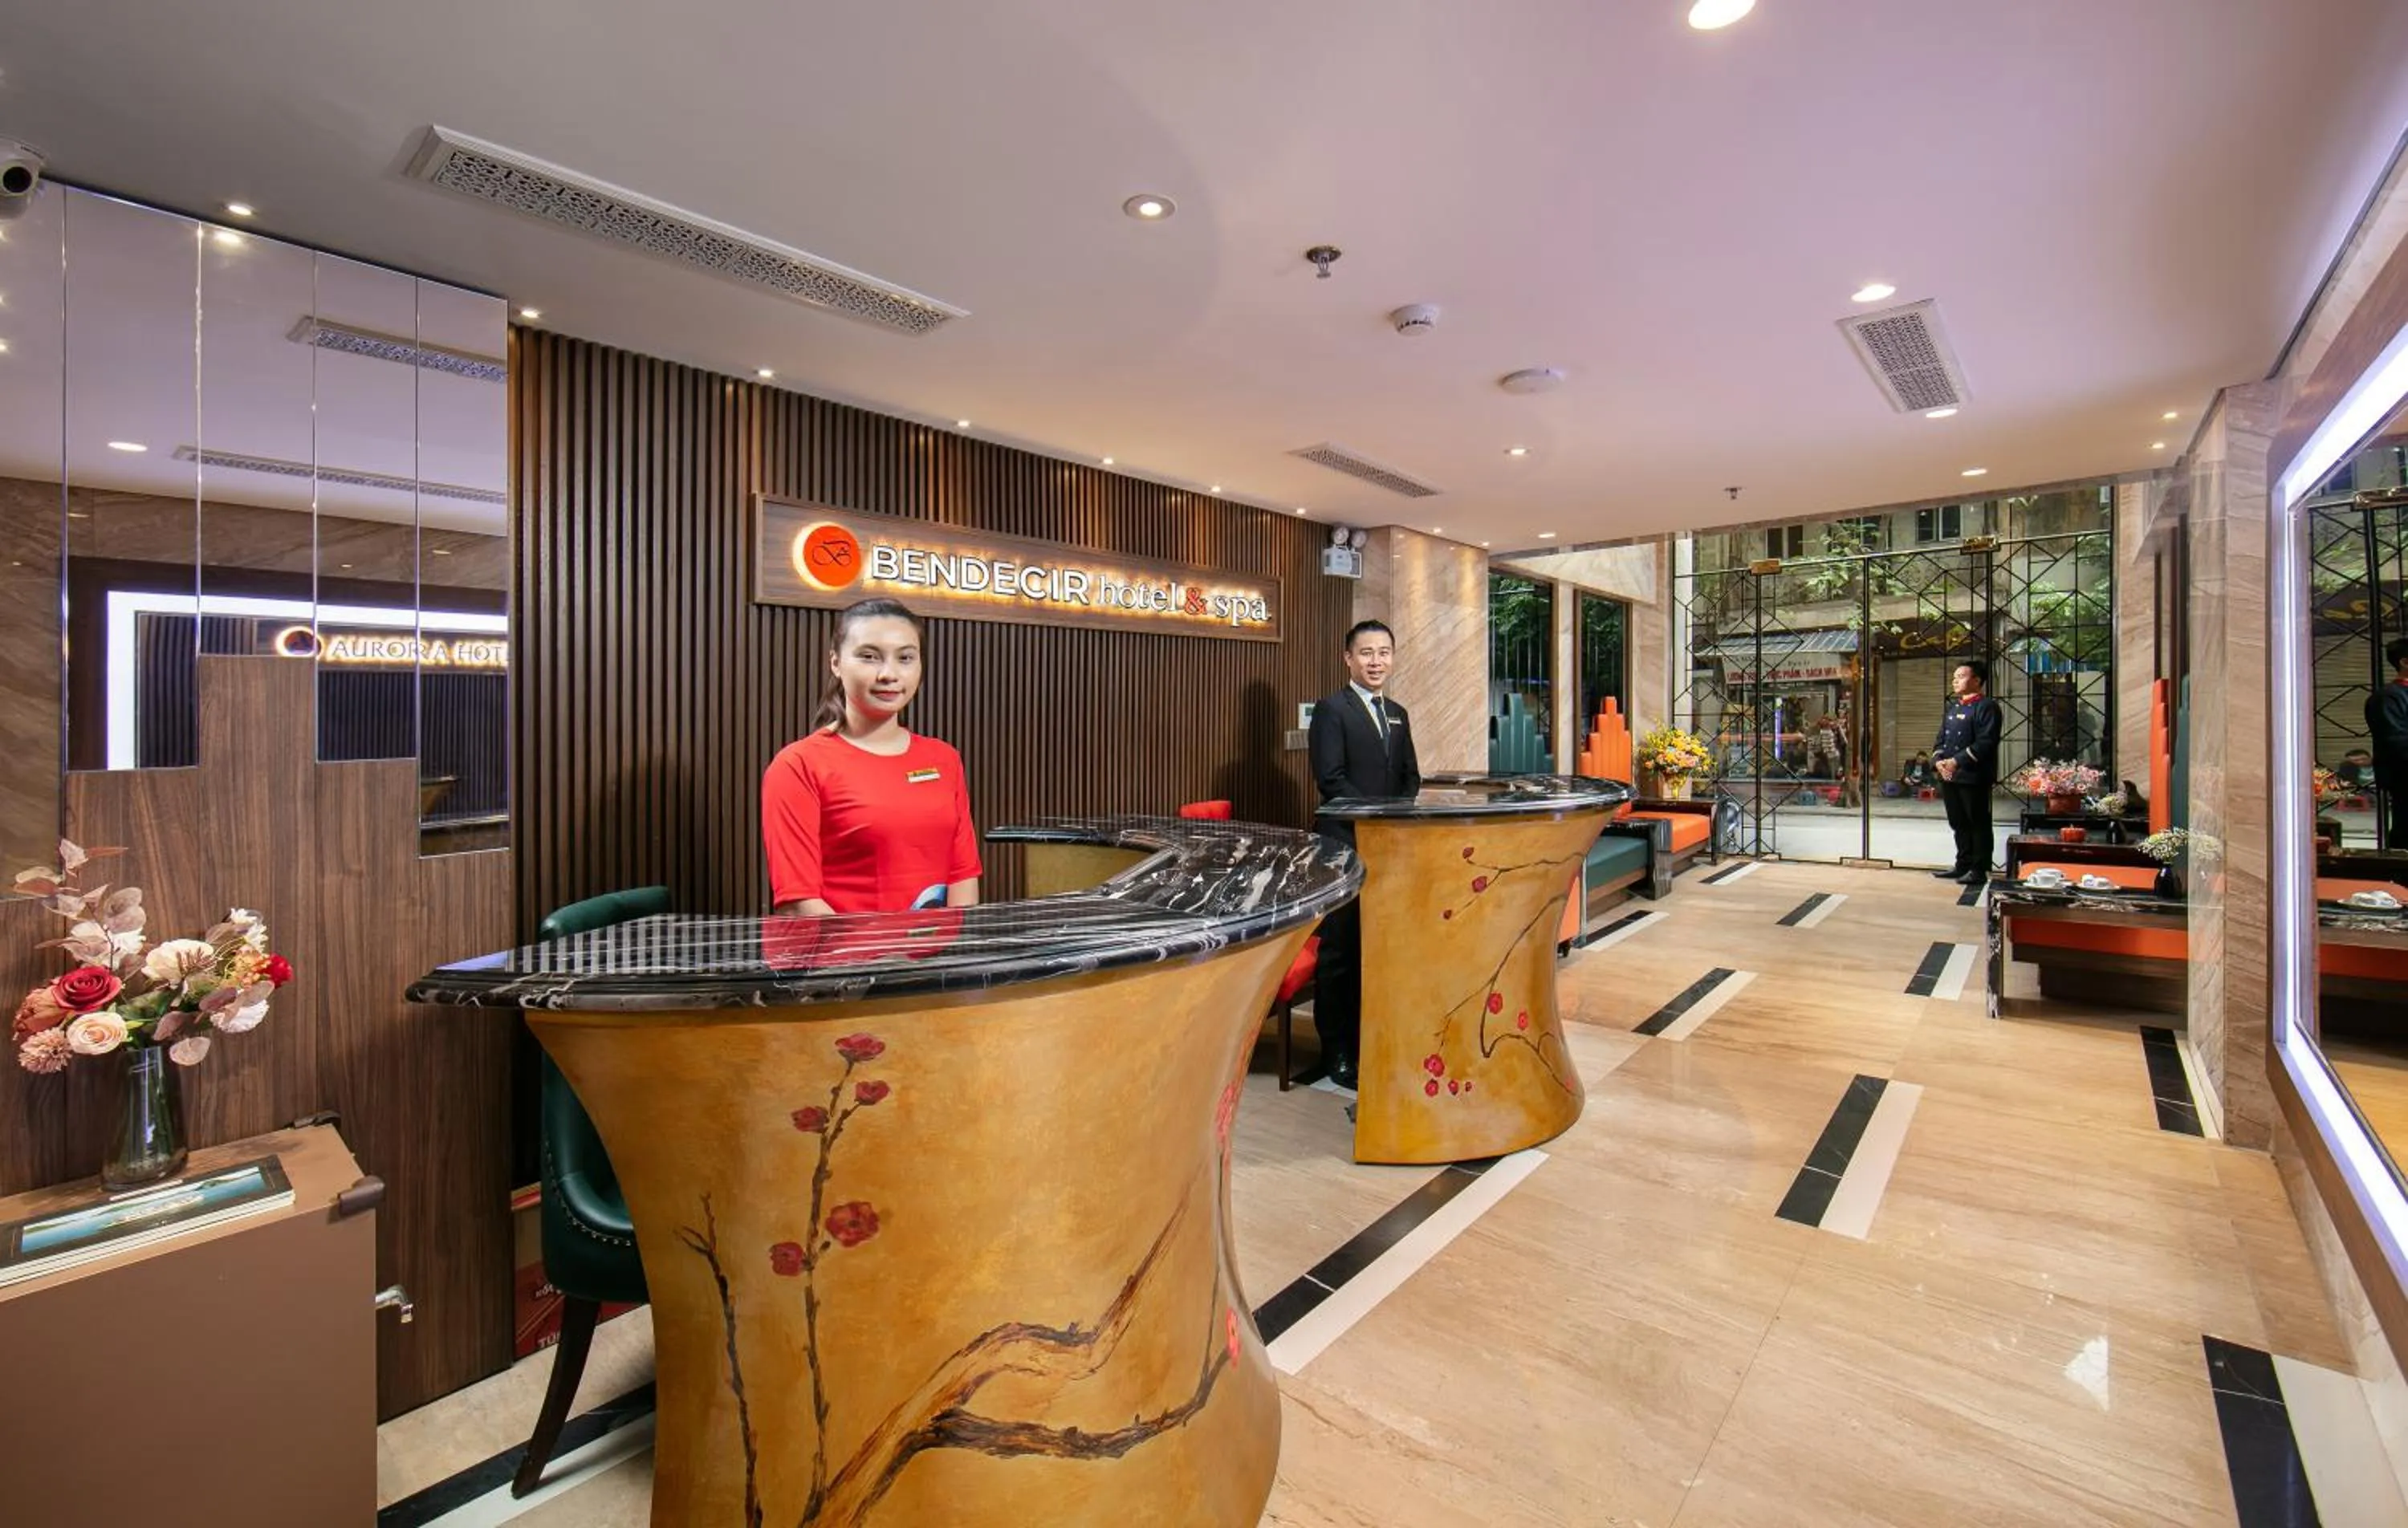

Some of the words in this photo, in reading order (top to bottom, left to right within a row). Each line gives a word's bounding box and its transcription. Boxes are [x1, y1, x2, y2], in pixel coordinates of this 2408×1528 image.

[872, 545, 1090, 605] BENDECIR
[1099, 575, 1177, 612] hotel
[1184, 587, 1208, 616] &
[1214, 593, 1271, 627] spa
[332, 640, 447, 661] AURORA
